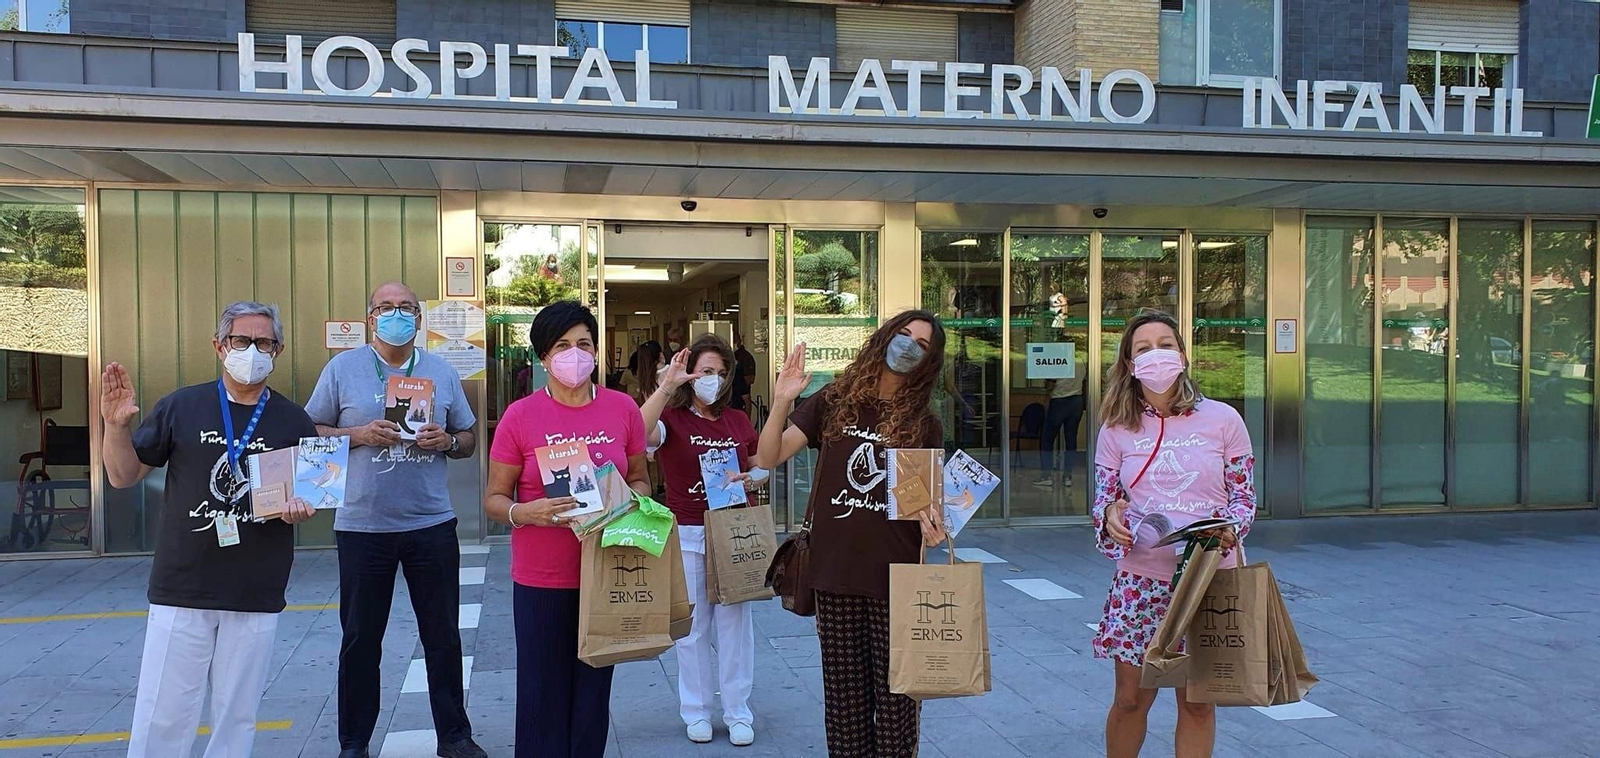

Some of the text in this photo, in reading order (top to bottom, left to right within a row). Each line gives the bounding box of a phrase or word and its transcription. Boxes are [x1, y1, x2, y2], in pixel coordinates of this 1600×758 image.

[238, 32, 1543, 137] HOSPITAL MATERNO INFANTIL
[804, 347, 860, 361] ENTRAD
[1035, 357, 1068, 366] SALIDA
[200, 430, 274, 451] Funaión
[842, 424, 891, 443] Fundaci
[690, 435, 740, 447] Fundación
[1133, 433, 1208, 451] Funación
[831, 489, 888, 519] Ligalism
[189, 501, 267, 532] Ligalis
[731, 550, 767, 564] ERMES
[609, 590, 654, 603] ERMES
[911, 628, 963, 641] ERMES
[1200, 634, 1245, 648] ERMES
